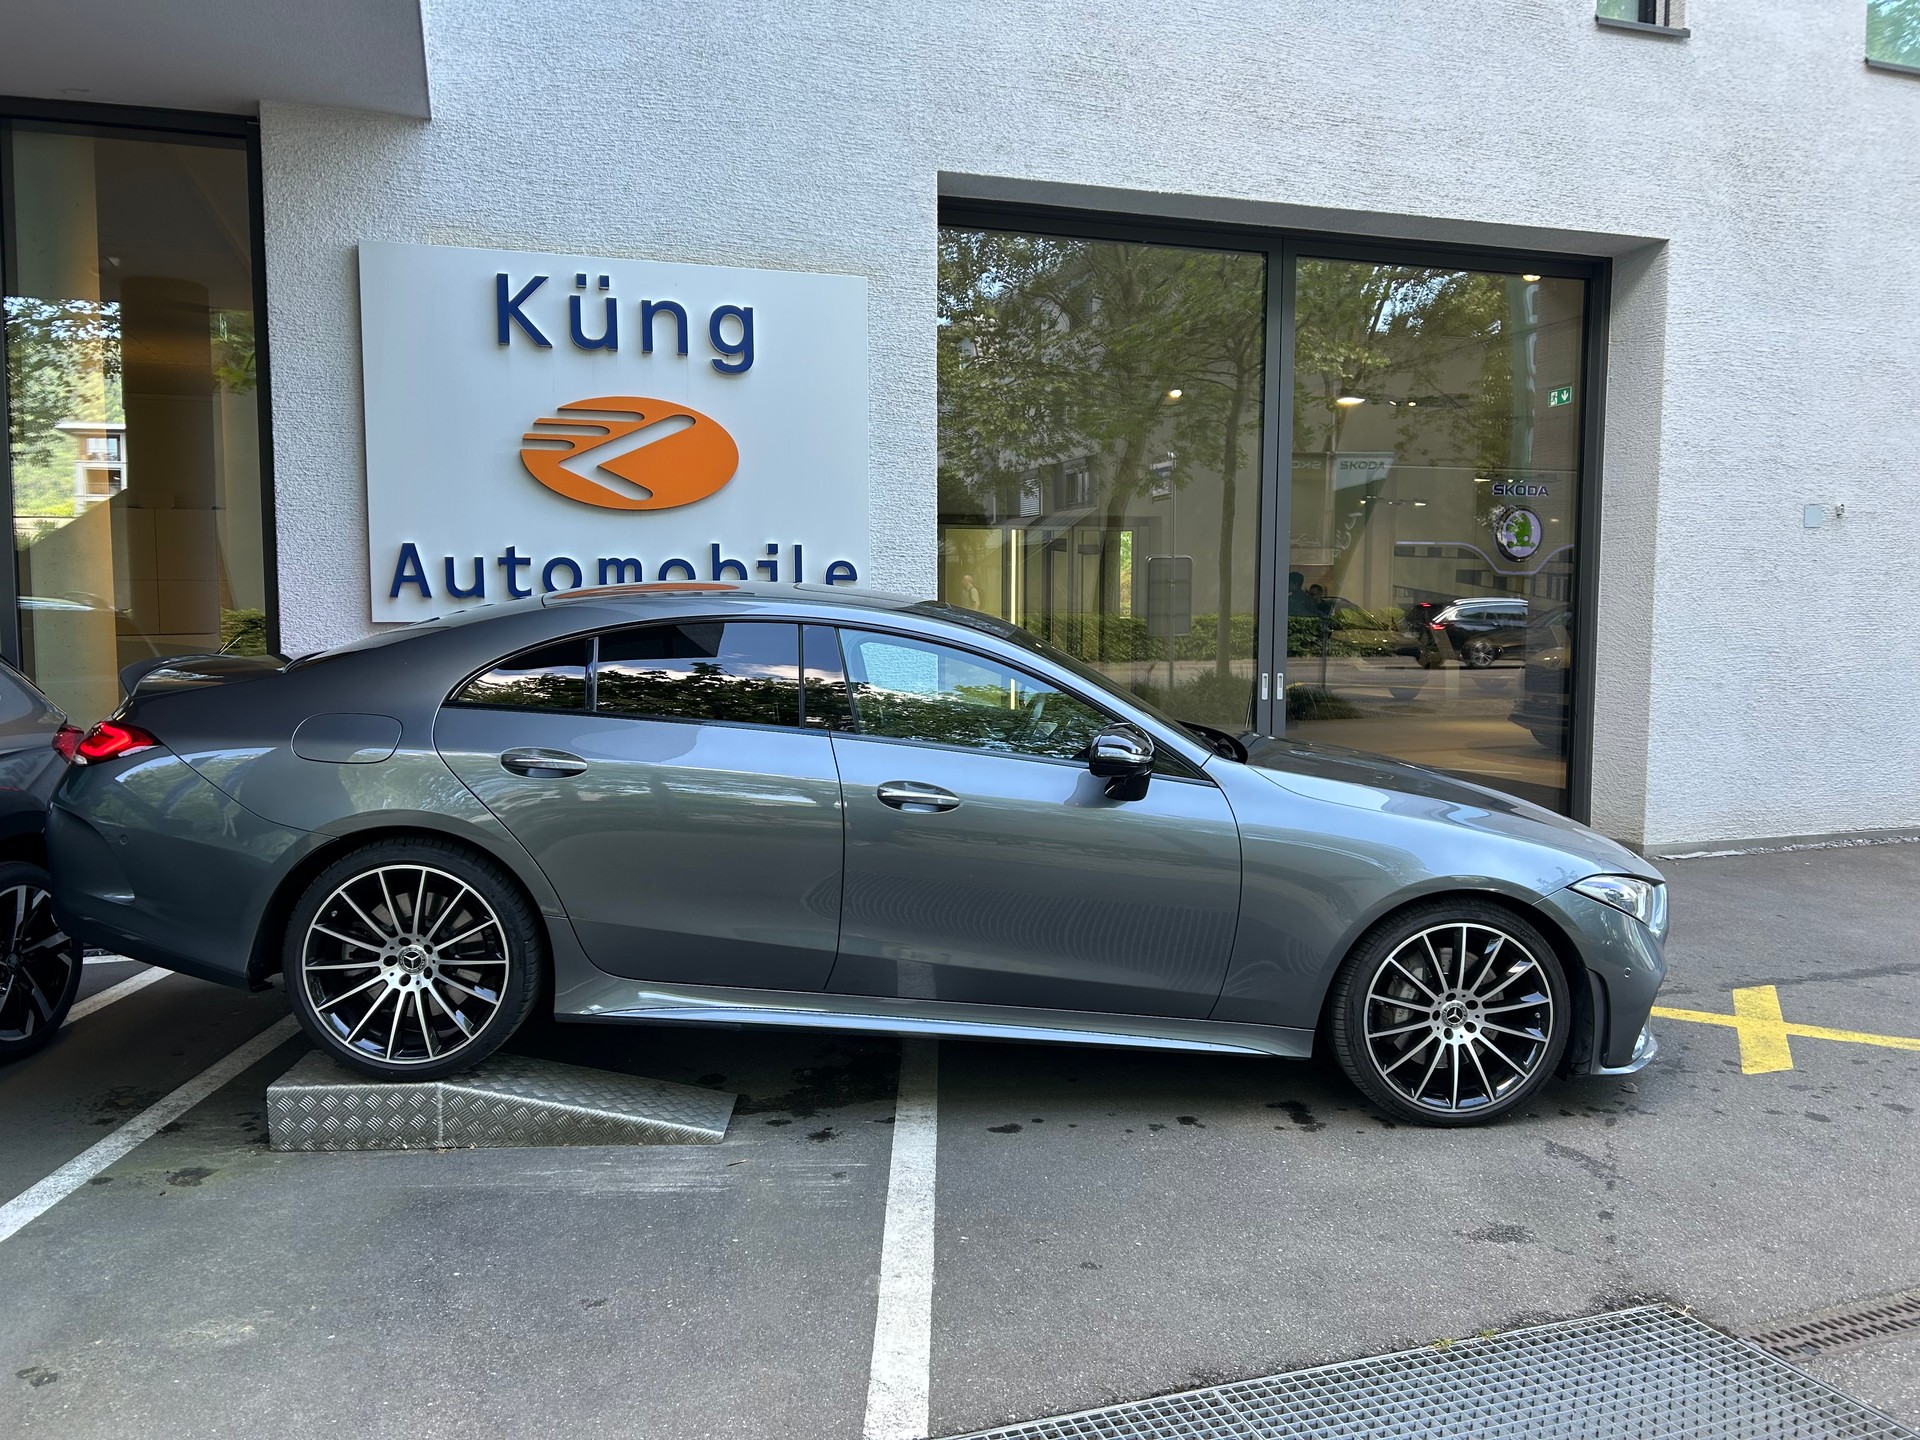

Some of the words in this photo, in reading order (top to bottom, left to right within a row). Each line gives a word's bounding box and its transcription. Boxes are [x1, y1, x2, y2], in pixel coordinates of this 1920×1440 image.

[496, 272, 754, 374] Küng
[1492, 481, 1549, 497] ŠKODA
[389, 542, 858, 598] Automobile
